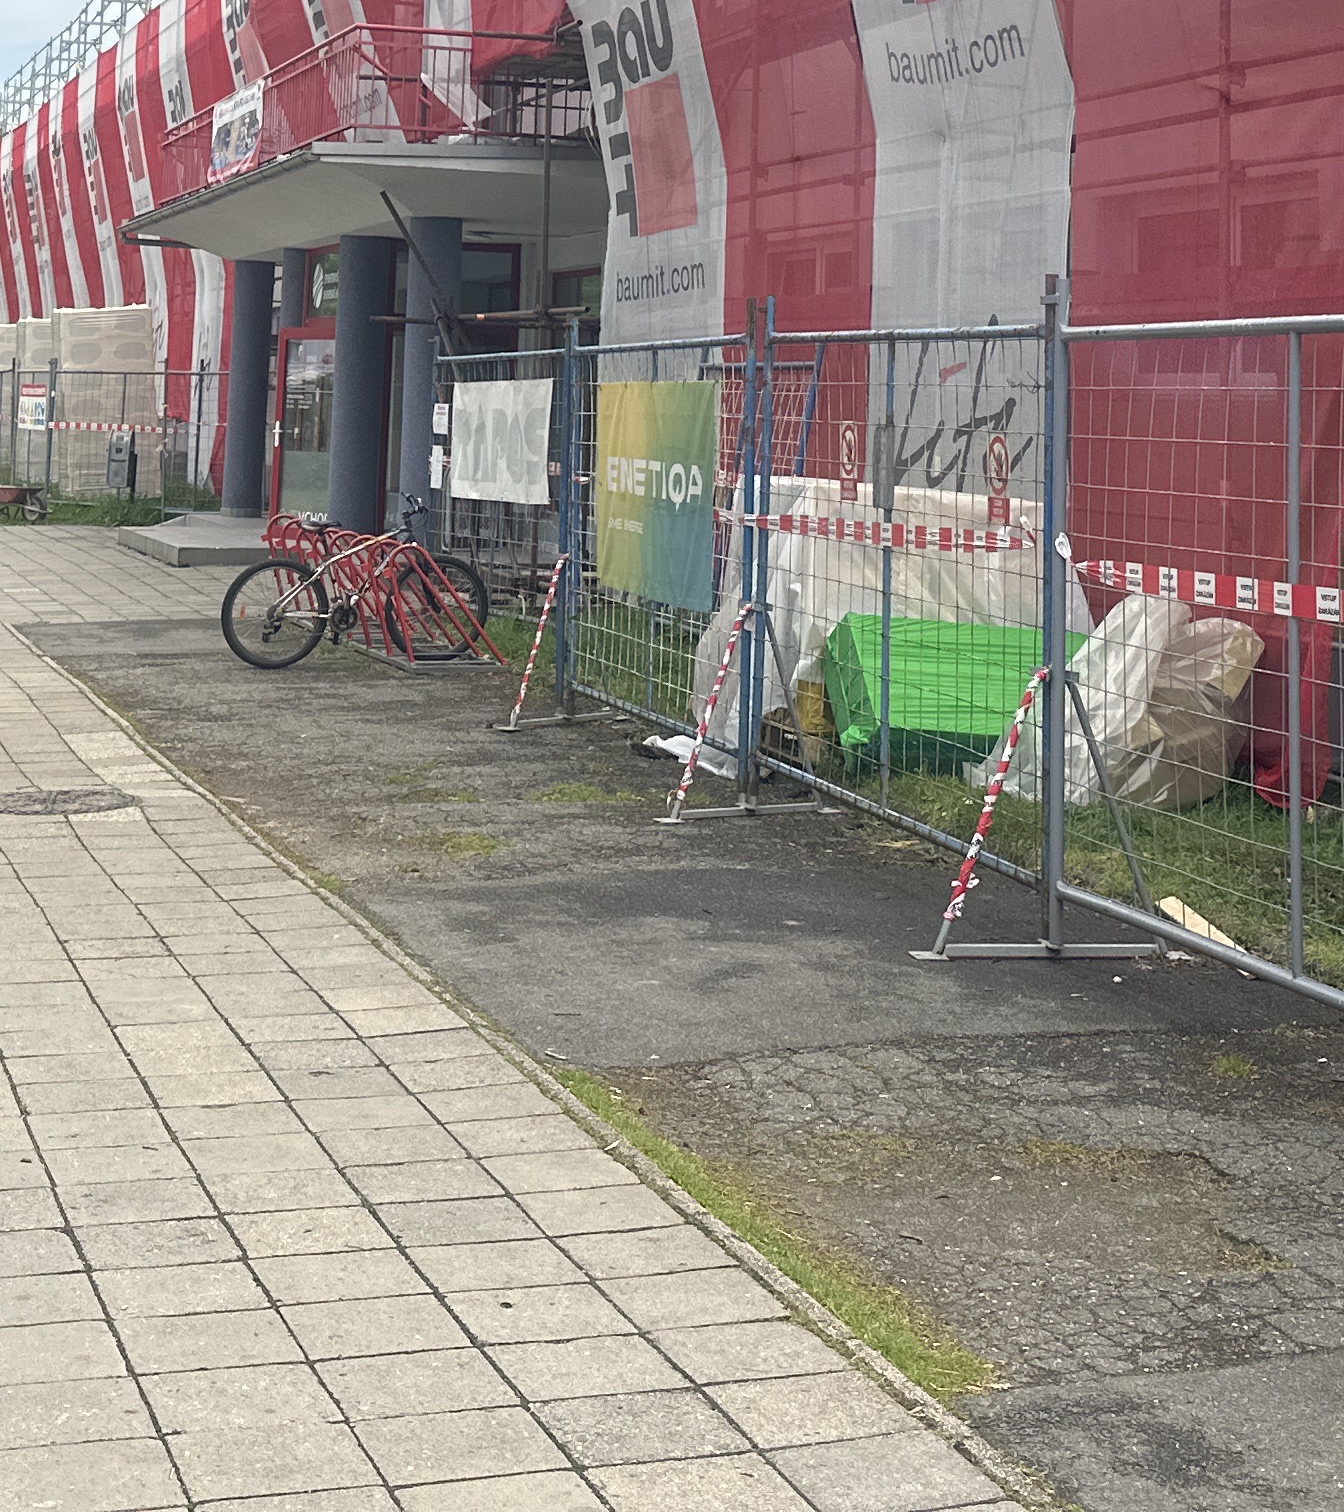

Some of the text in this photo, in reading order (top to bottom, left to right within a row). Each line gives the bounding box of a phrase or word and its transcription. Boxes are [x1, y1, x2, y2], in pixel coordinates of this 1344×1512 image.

[885, 24, 1025, 85] baumit.com
[616, 262, 706, 303] baumit.com
[607, 456, 703, 513] ENETIQA
